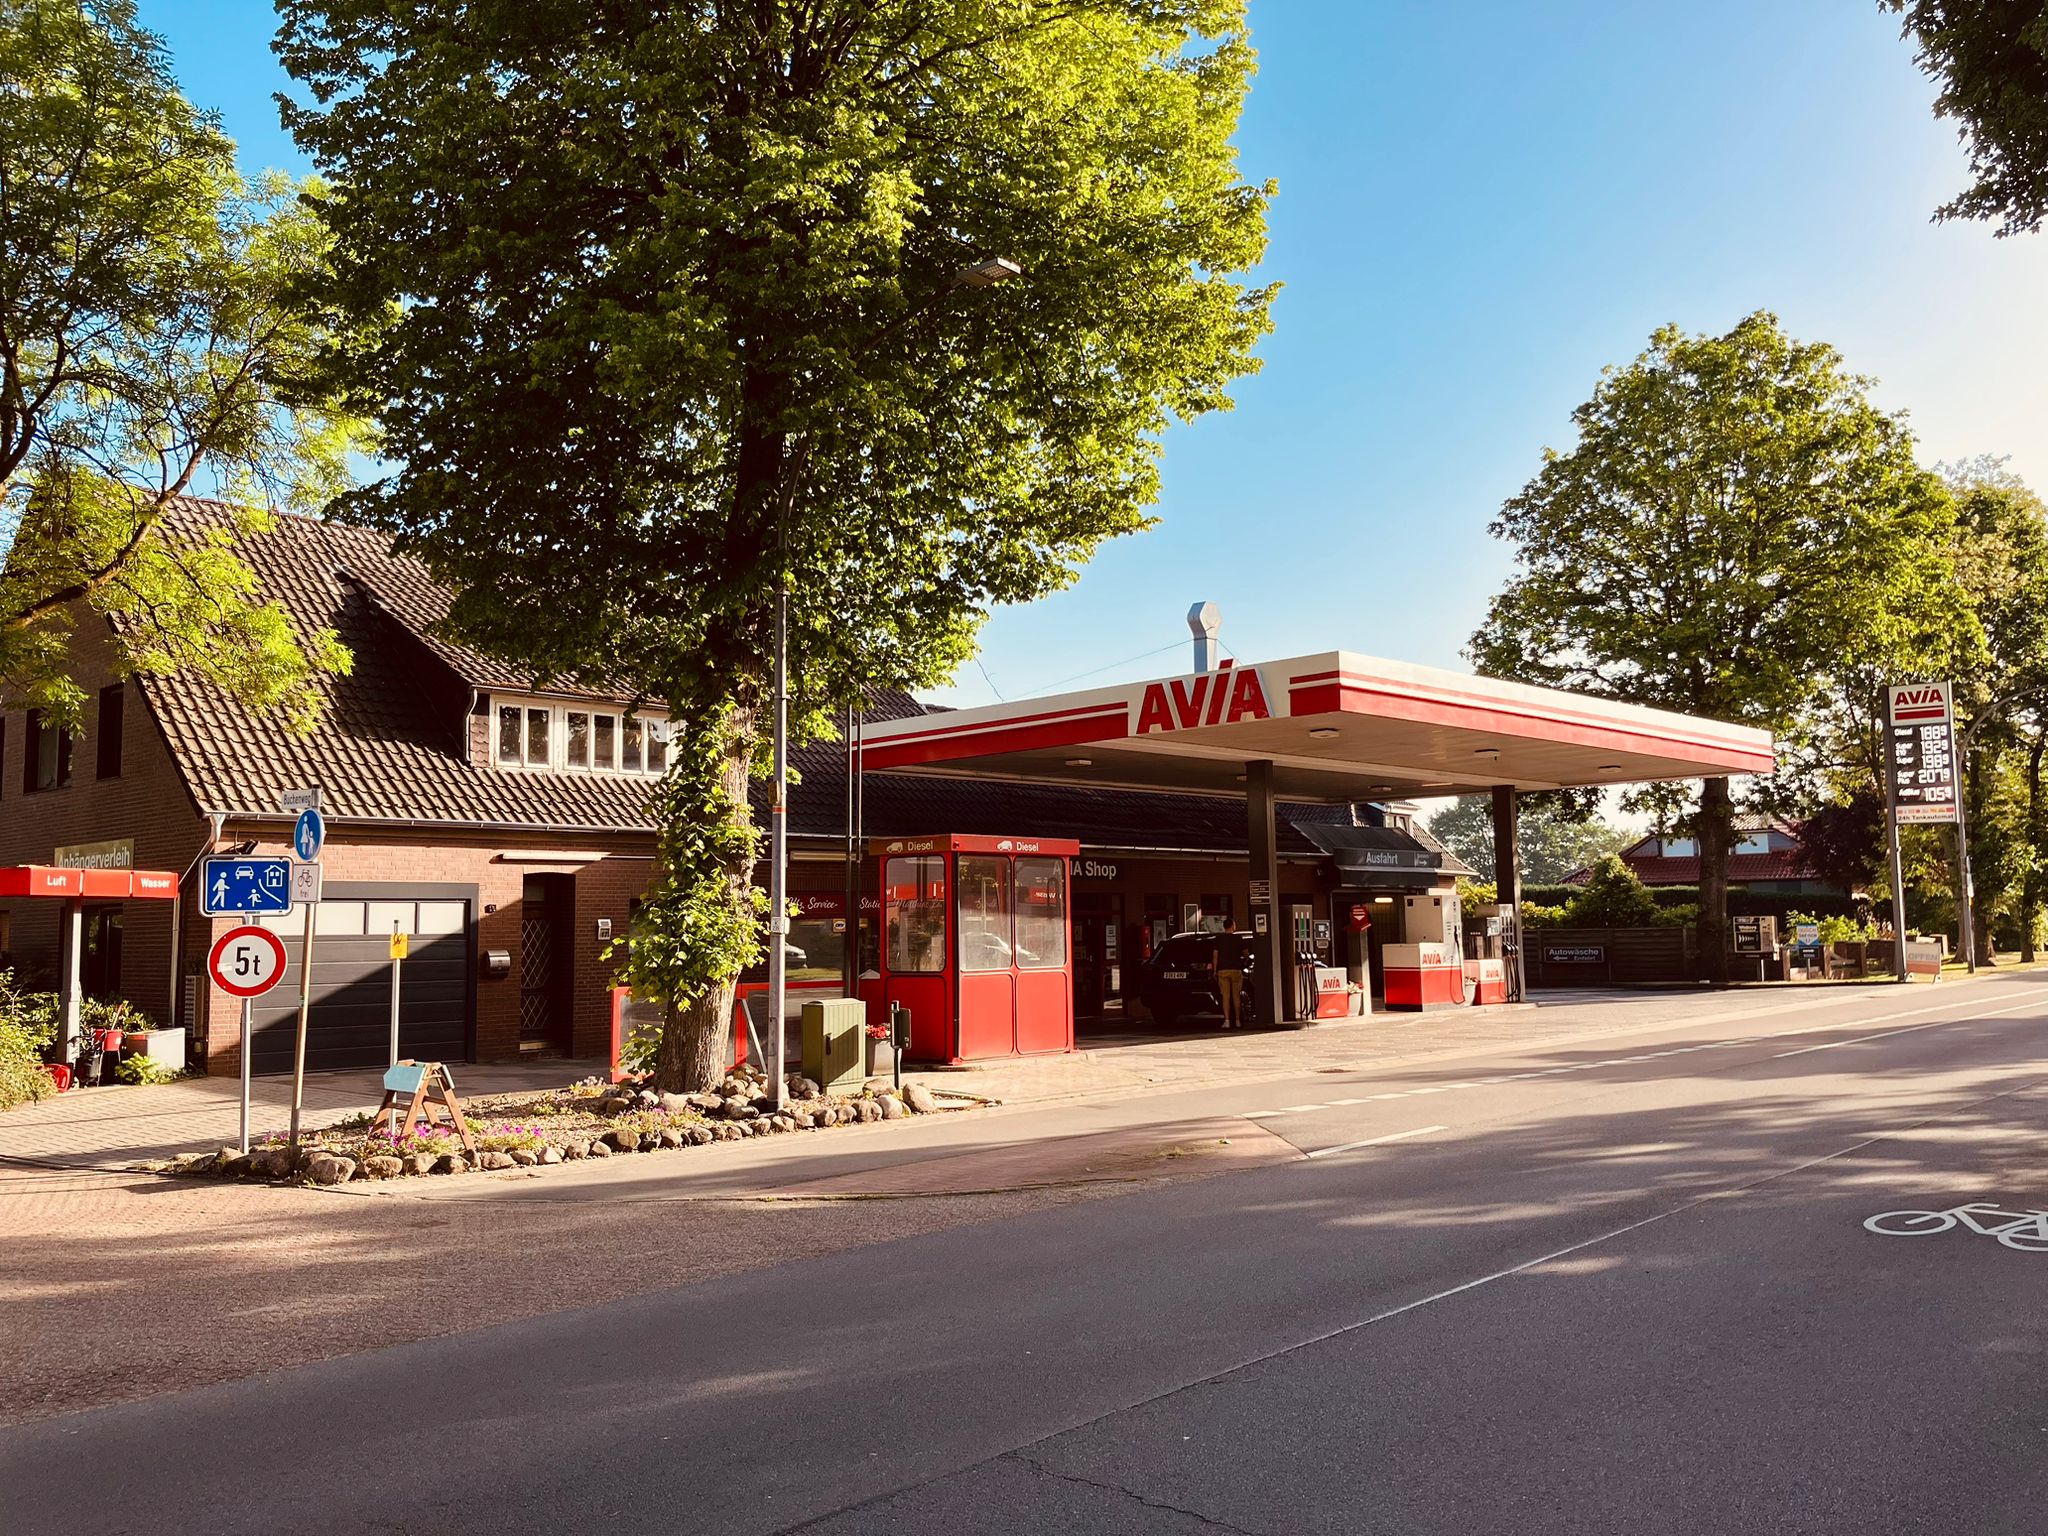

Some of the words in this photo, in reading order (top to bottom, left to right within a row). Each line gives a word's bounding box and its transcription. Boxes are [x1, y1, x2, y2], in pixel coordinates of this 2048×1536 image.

[1895, 686, 1944, 706] AVIA
[1894, 728, 1913, 736] Diesel
[1895, 742, 1913, 750] Super
[1896, 756, 1914, 764] Super
[1897, 770, 1915, 778] Super
[907, 841, 934, 851] Diesel
[1016, 841, 1039, 852] Diesel
[1366, 851, 1398, 864] Ausfahrt
[1053, 861, 1083, 876] AIA
[1085, 861, 1117, 880] Shop
[47, 875, 67, 886] Luft
[140, 878, 171, 888] Wasser
[1422, 950, 1441, 965] AVIA
[1486, 968, 1499, 978] AVIA
[1323, 976, 1340, 989] AVIA
